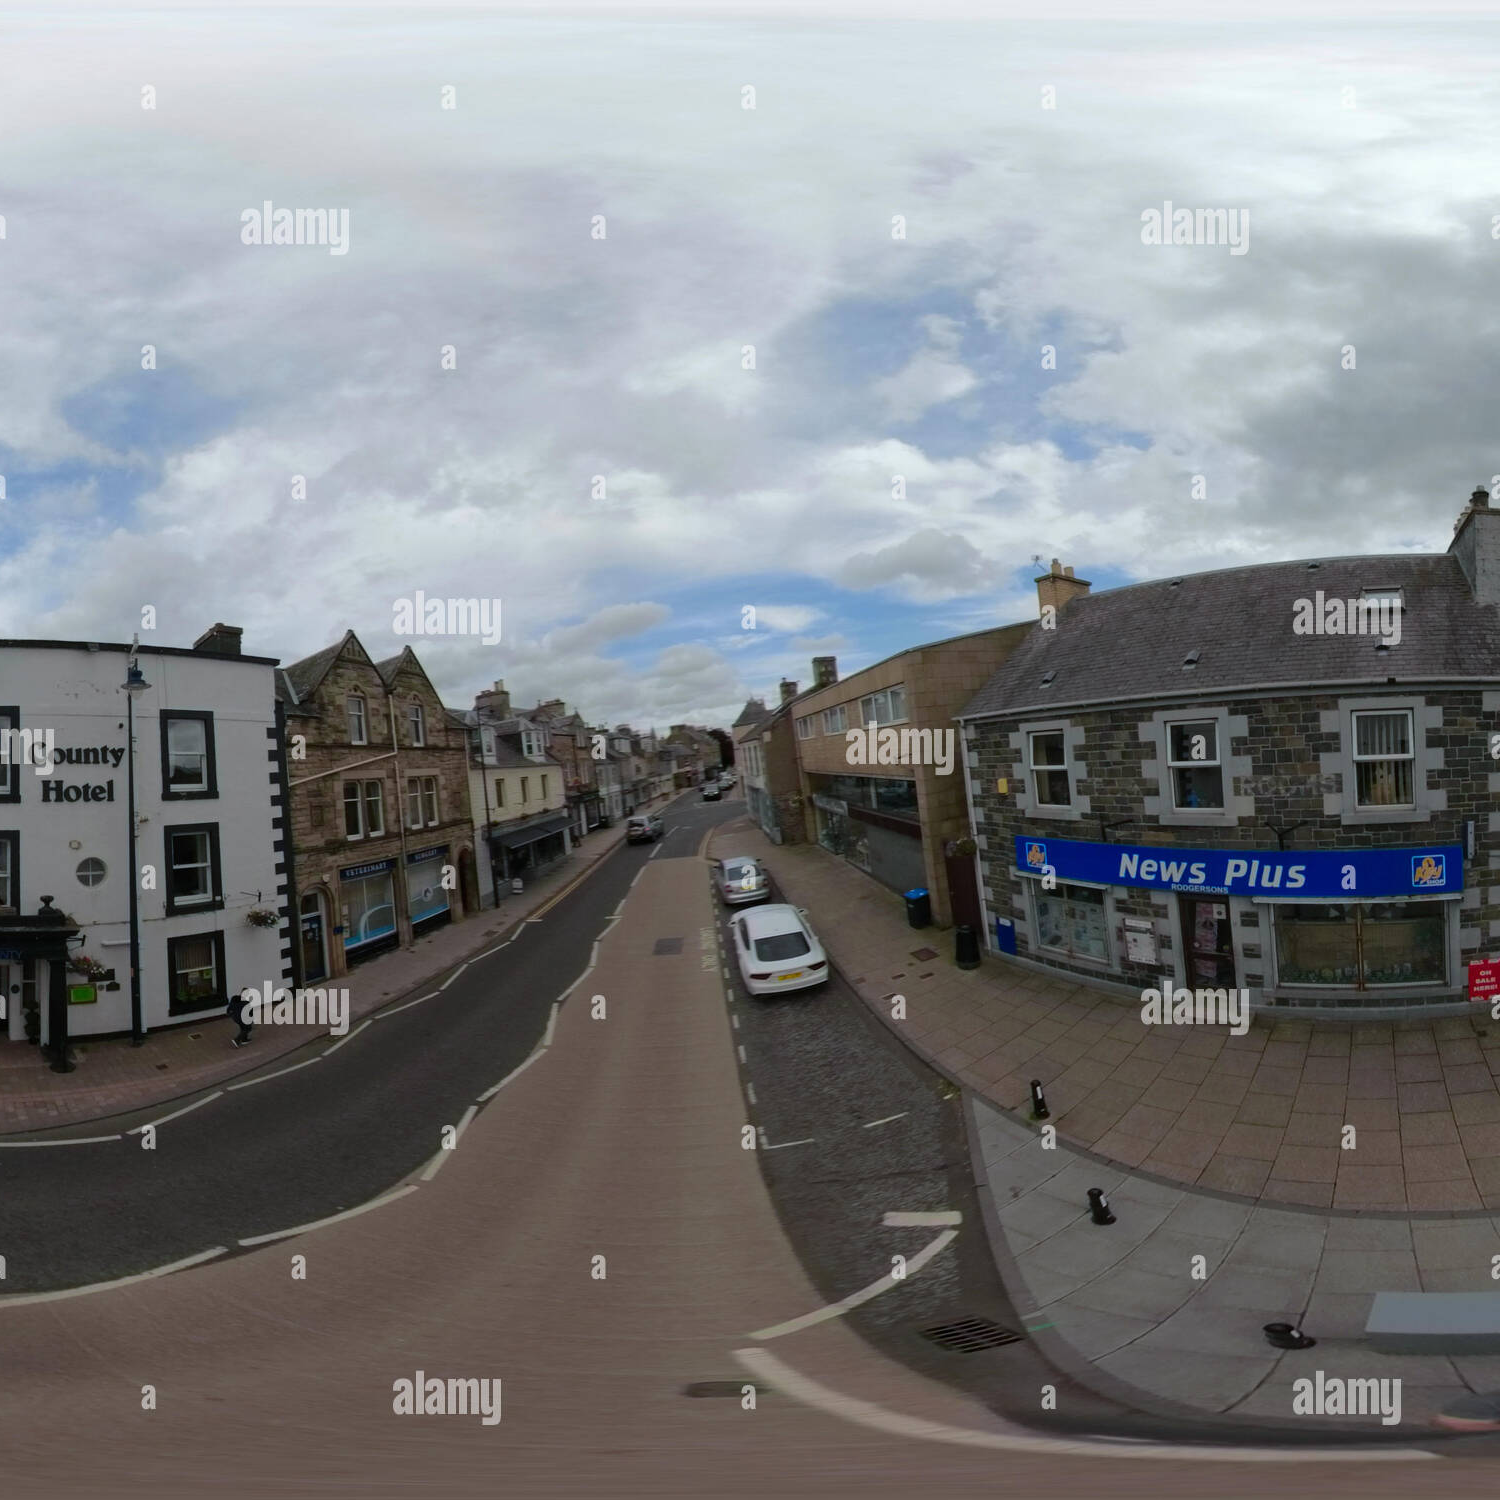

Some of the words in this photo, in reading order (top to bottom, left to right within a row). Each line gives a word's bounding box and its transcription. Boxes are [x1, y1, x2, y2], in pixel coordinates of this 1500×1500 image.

[28, 741, 125, 768] County
[41, 779, 115, 802] Hotel
[1119, 853, 1206, 885] News
[1224, 859, 1306, 888] Plus
